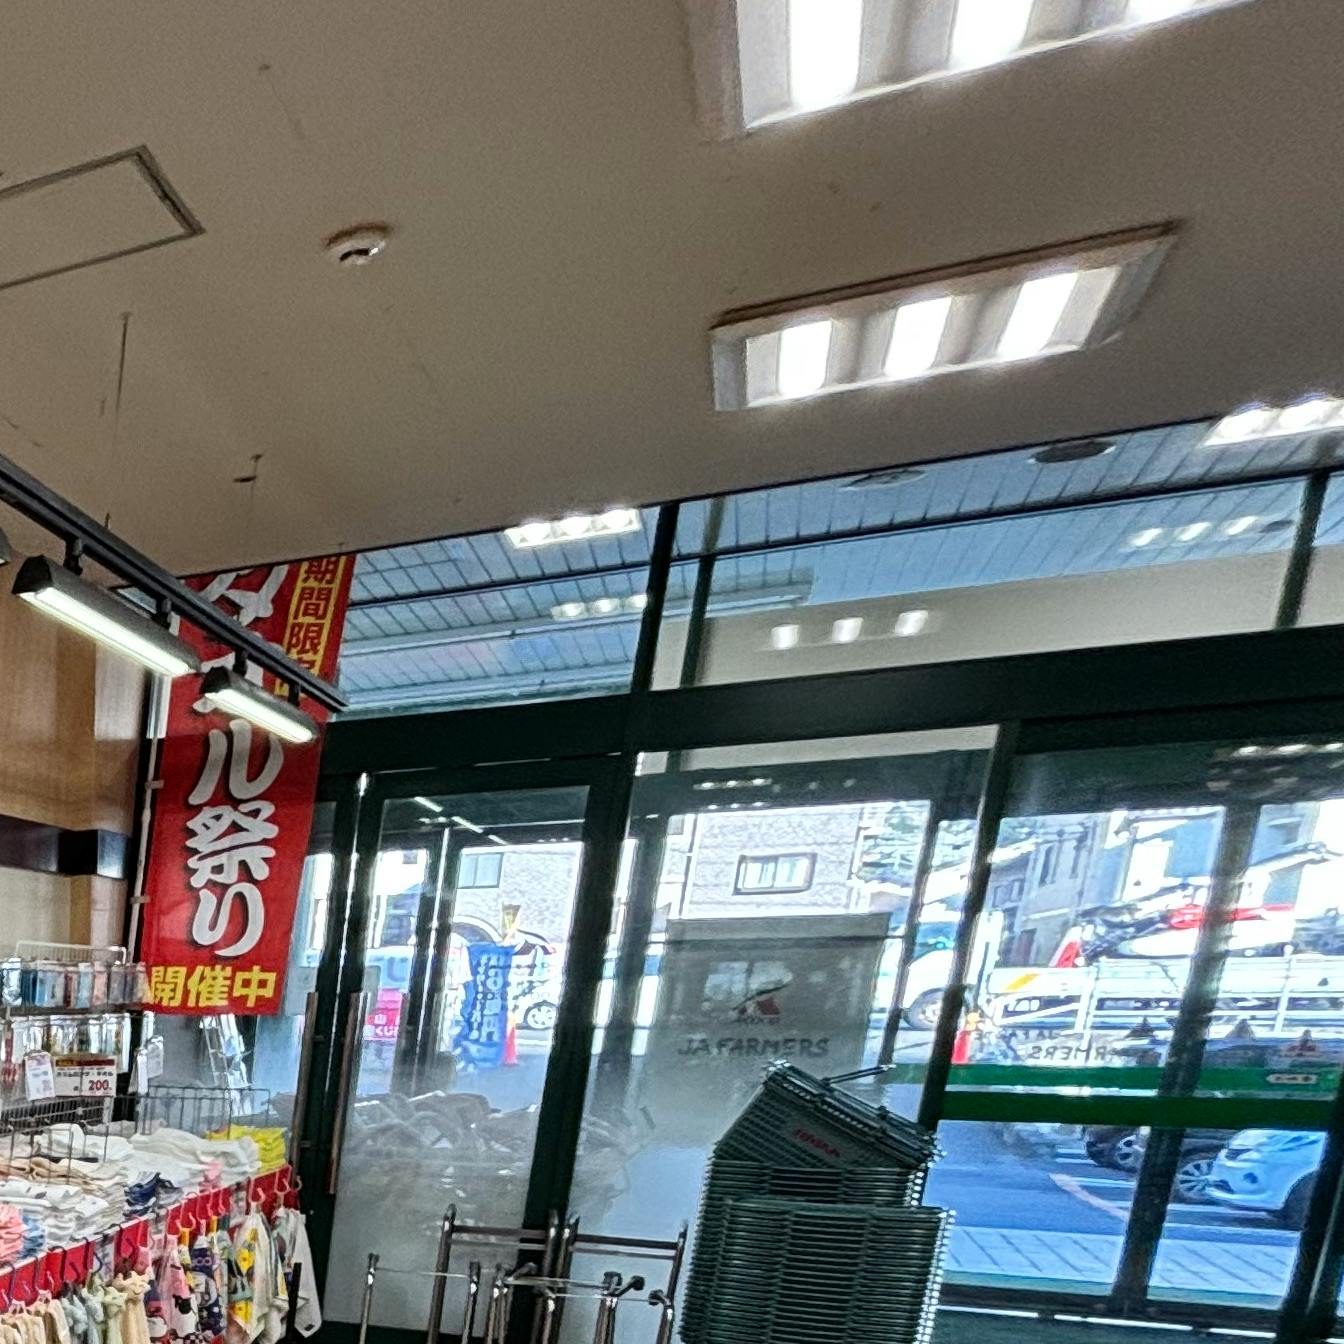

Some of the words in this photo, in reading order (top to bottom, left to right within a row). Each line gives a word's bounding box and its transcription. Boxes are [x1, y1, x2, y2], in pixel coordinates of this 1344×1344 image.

[184, 564, 289, 958] タル祭り
[150, 963, 277, 1008] 開催中
[678, 1038, 710, 1056] JA
[716, 1037, 831, 1057] FARMERS
